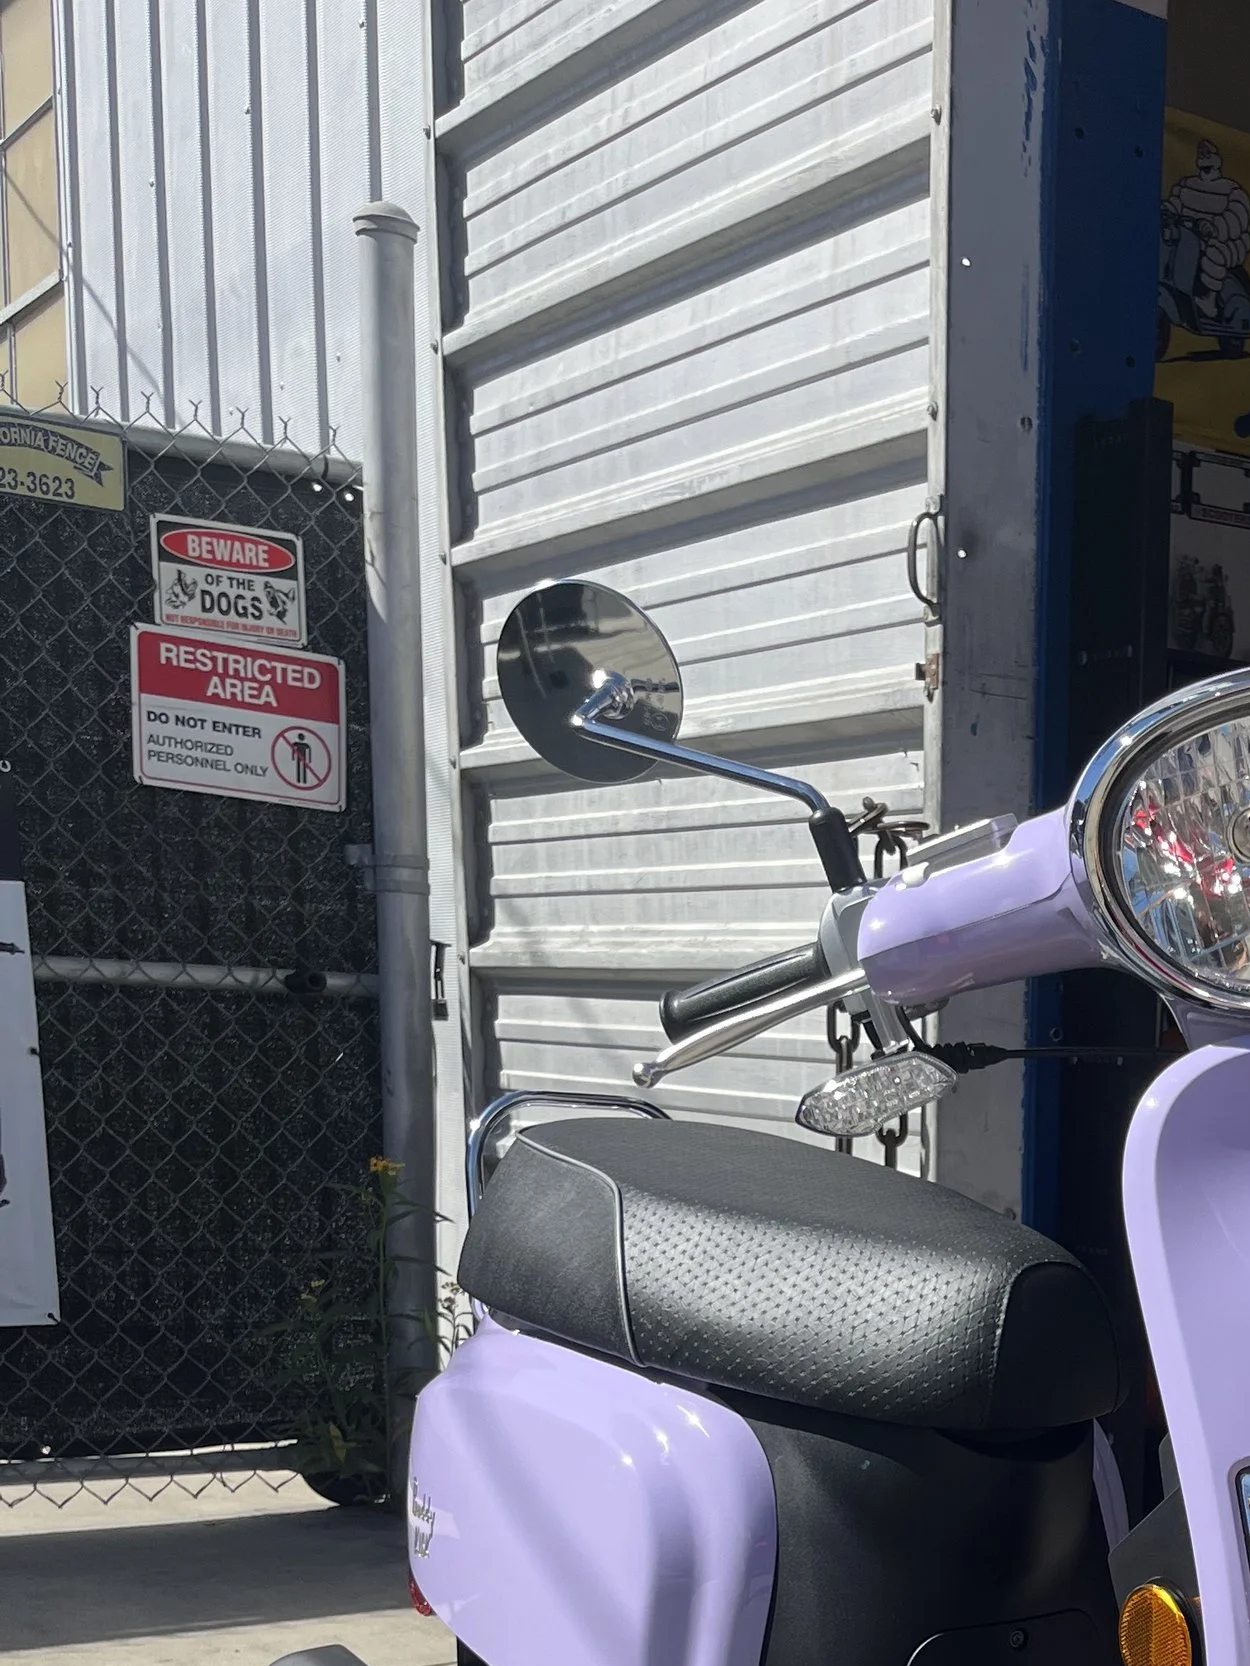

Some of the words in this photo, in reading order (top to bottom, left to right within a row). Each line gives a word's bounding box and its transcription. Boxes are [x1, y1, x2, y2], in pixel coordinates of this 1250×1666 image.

[48, 435, 98, 469] FENCE
[187, 535, 269, 567] BEWARE
[205, 574, 223, 587] OF
[227, 577, 255, 591] THE
[200, 590, 263, 620] DOGS
[160, 642, 321, 689] RESTRICTED
[206, 676, 278, 707] AREA
[147, 711, 169, 724] DO
[175, 715, 206, 730] NOT
[212, 721, 262, 739] ENTER
[147, 734, 234, 756] AUTHORIZED
[148, 750, 231, 772] PERSONNEL
[234, 762, 268, 777] ONLY
